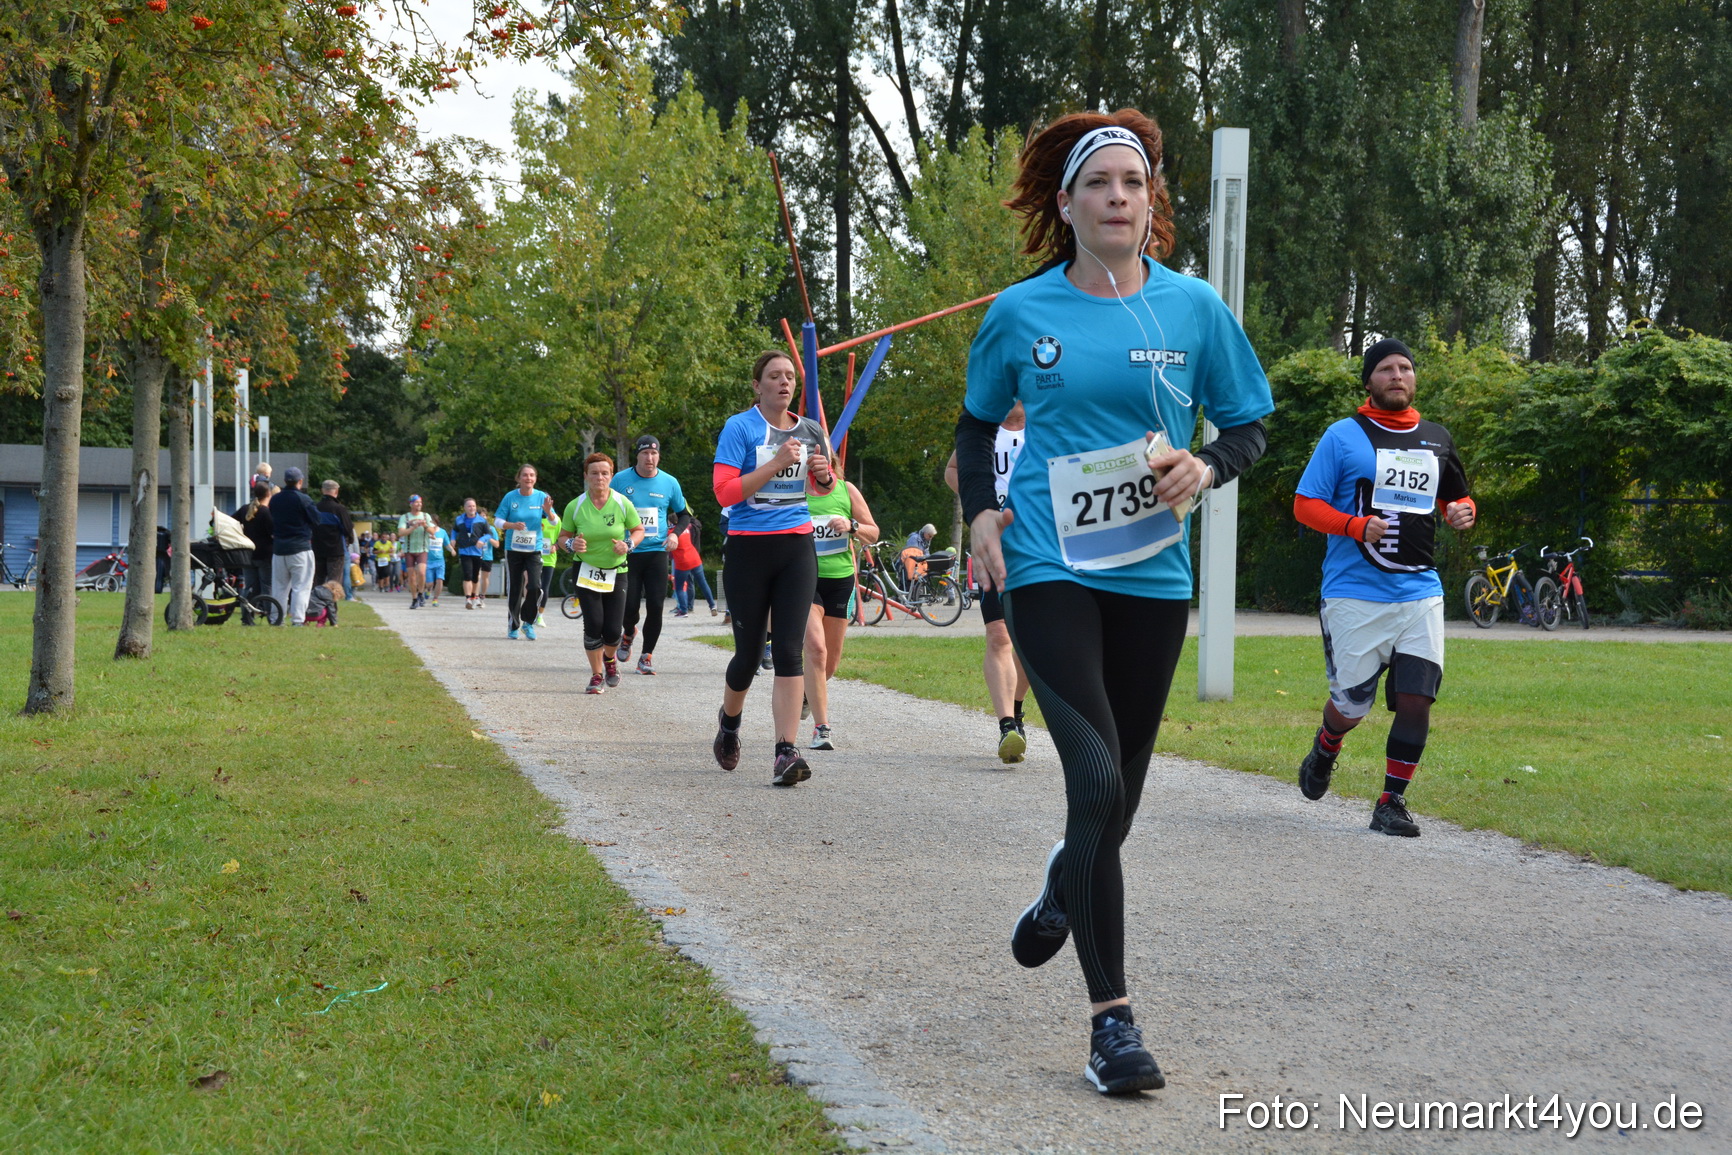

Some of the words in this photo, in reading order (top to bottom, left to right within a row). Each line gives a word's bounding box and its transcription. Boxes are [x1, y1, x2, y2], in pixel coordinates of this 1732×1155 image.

[1129, 349, 1187, 366] BOCK
[772, 461, 801, 478] 067
[1094, 453, 1137, 472] BOCK
[1384, 468, 1429, 491] 2152
[1071, 474, 1160, 527] 2739
[1393, 493, 1417, 504] Markus
